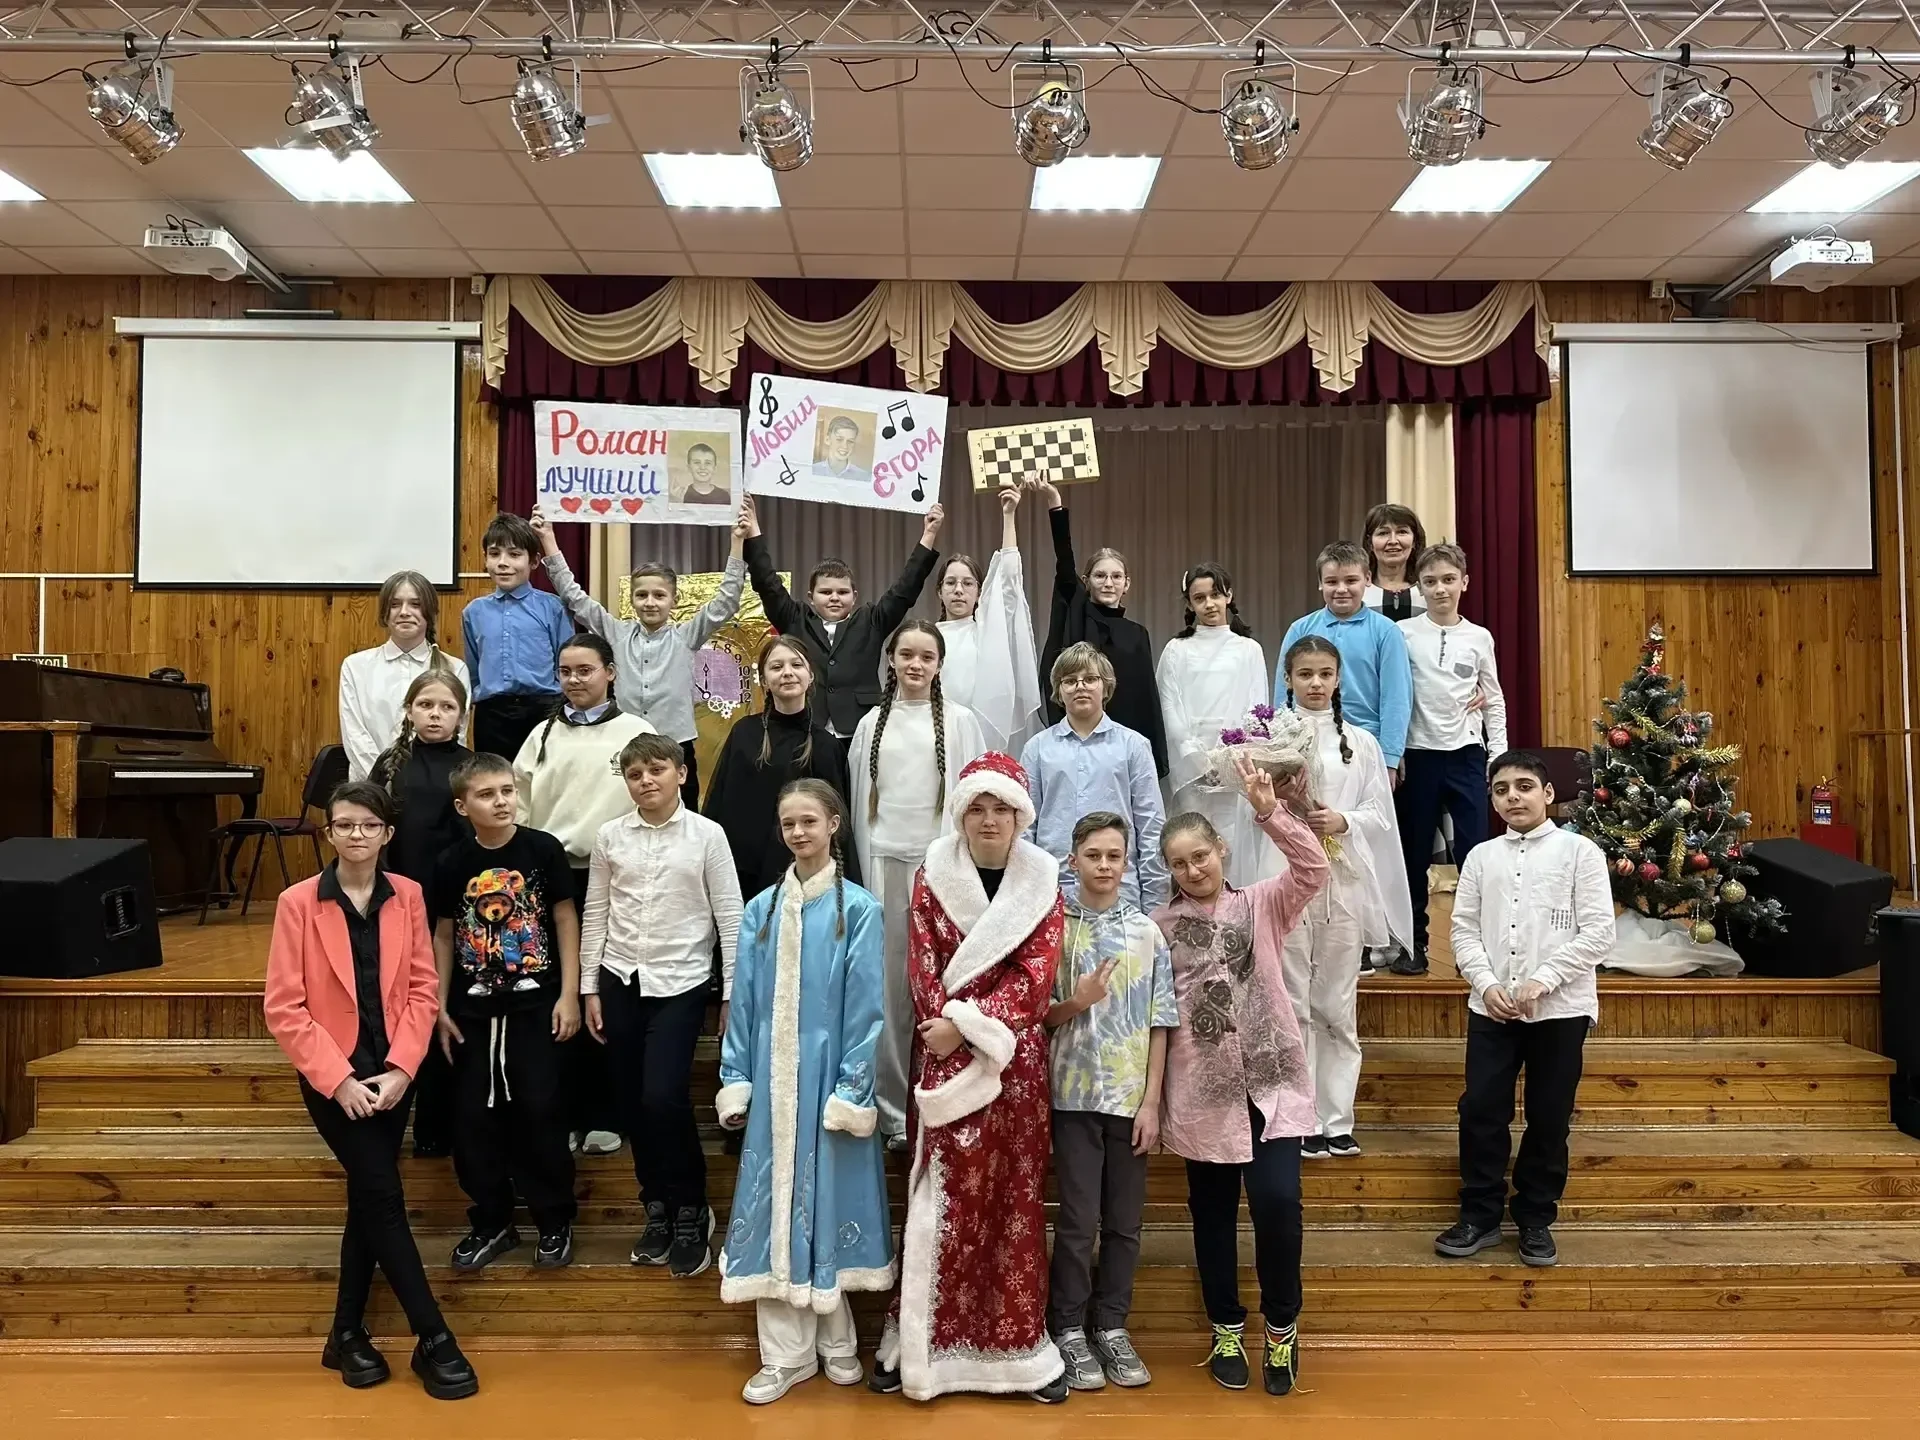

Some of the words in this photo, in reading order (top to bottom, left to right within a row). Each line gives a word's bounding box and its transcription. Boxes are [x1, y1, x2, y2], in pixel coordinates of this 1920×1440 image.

[551, 409, 667, 456] Роман
[711, 640, 718, 651] 7
[724, 643, 732, 654] 8
[734, 653, 742, 663] 9
[738, 665, 750, 677] 10
[739, 679, 750, 690] 11
[739, 692, 752, 704] 12
